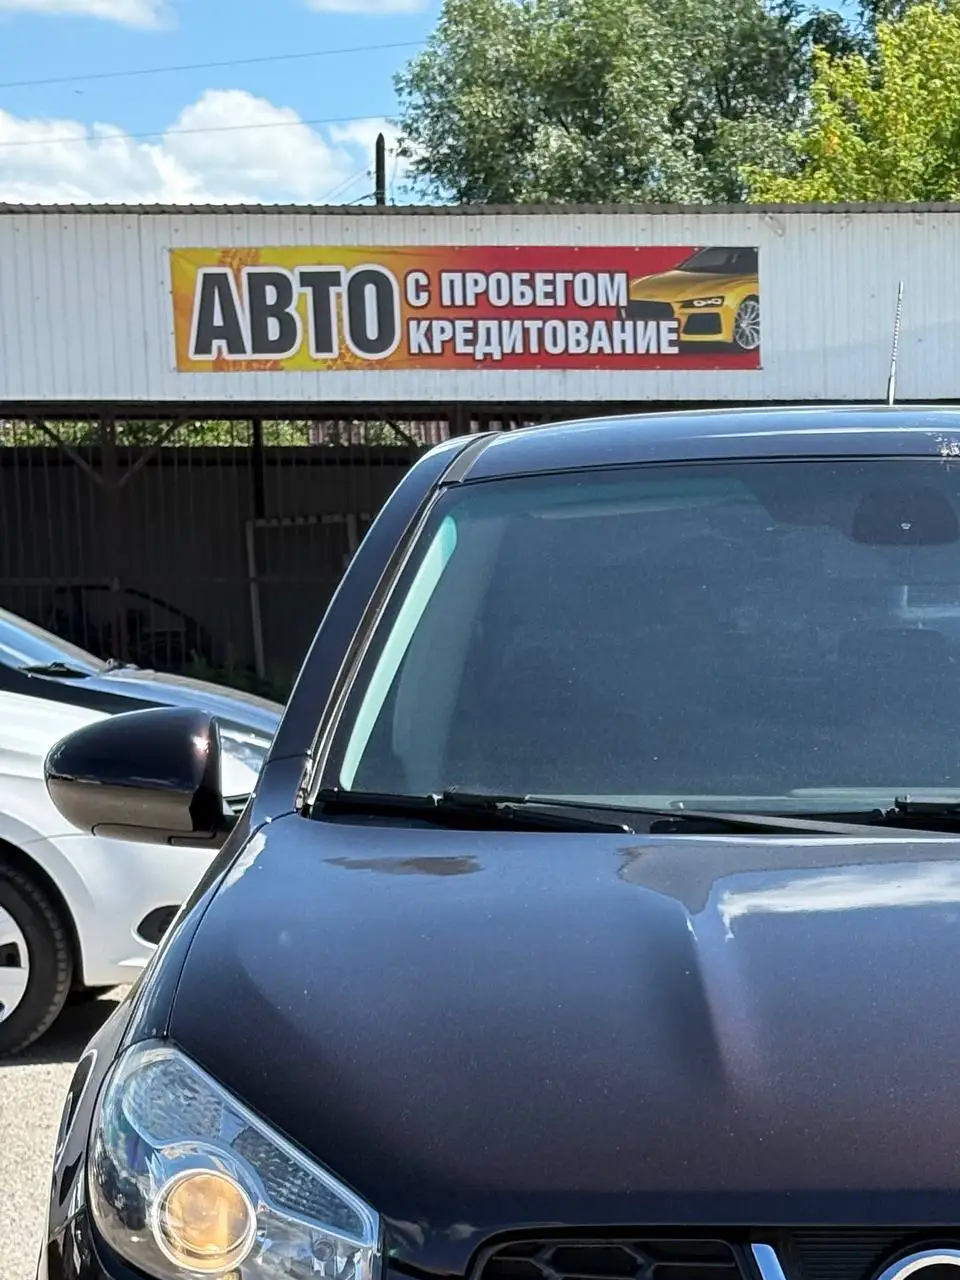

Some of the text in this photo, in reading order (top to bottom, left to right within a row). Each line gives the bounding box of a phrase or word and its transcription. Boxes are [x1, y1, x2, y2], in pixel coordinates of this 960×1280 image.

[406, 271, 628, 308] С ПРОБЕГОМ
[190, 264, 400, 360] АВТО
[407, 318, 680, 361] КРЕДИТОВАНИЕ
